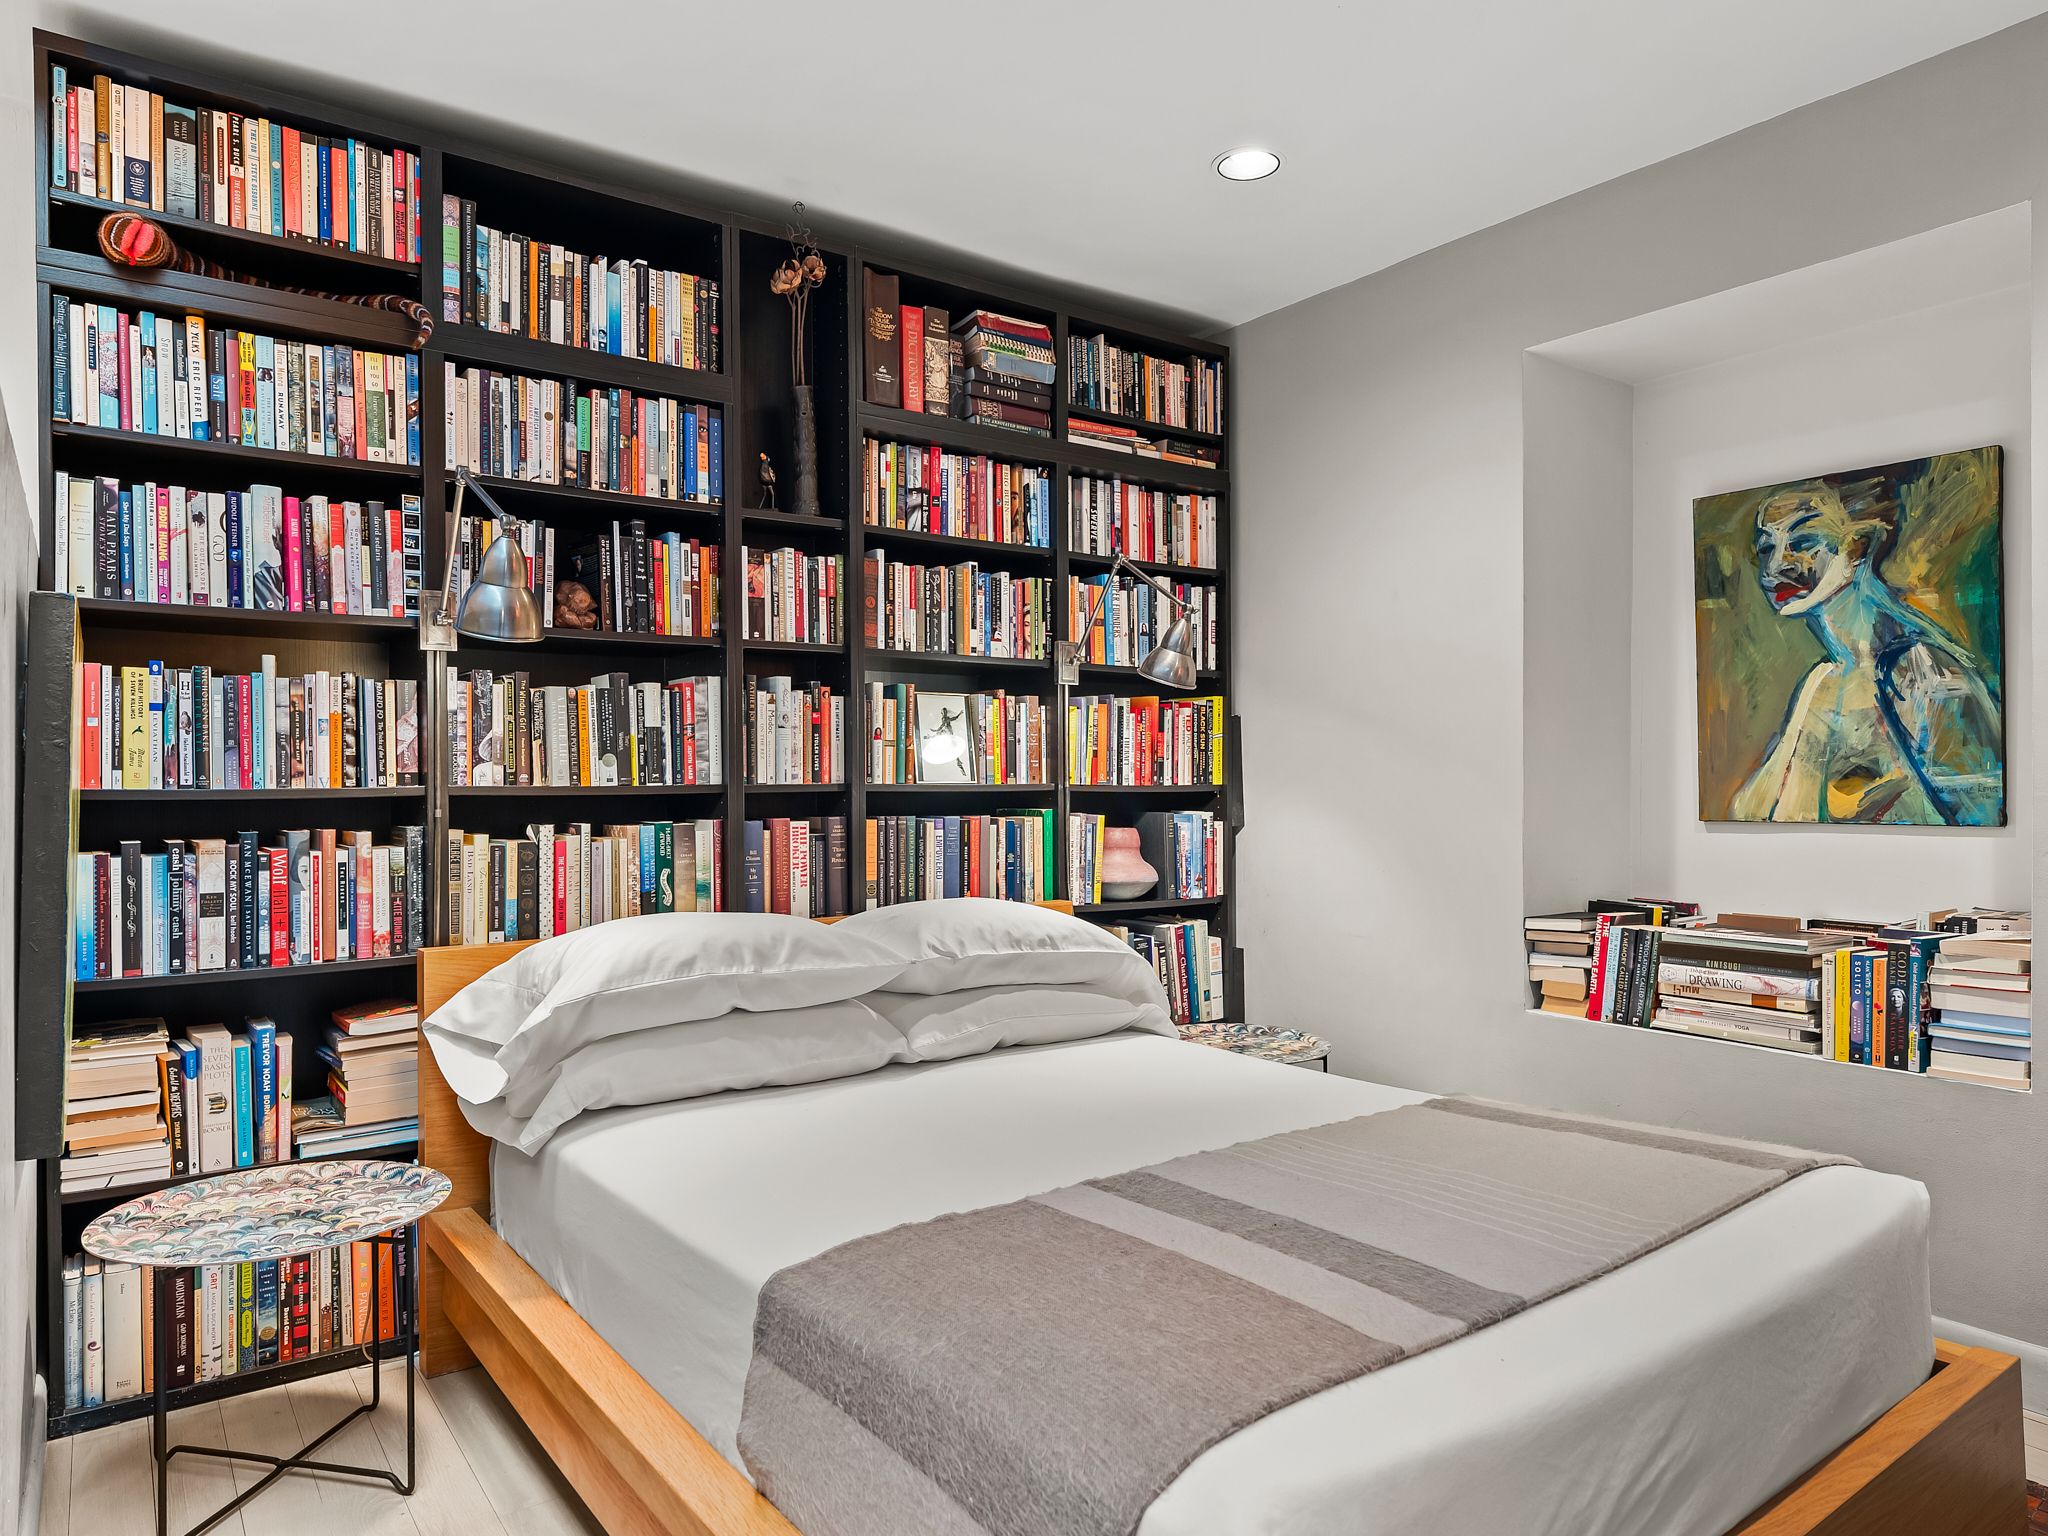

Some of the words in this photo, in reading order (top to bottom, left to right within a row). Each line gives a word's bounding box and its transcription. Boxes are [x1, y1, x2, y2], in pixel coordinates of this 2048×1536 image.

[233, 116, 241, 137] PEARL
[233, 148, 241, 165] BUCK
[289, 132, 301, 191] BIRDSONG
[58, 299, 66, 325] Setting
[58, 333, 66, 352] Table
[161, 338, 171, 360] Snow
[191, 331, 200, 353] YOLKS
[193, 360, 202, 382] ERIC
[907, 330, 919, 400] DICTIONARY
[57, 369, 66, 391] Danny
[213, 376, 223, 398] Salt
[57, 391, 66, 410] Meyer
[193, 386, 202, 418] RIPERT
[371, 395, 381, 416] bruce
[371, 418, 381, 444] wagner
[159, 505, 168, 529] EDDIE
[231, 496, 239, 520] RUDOLF
[58, 515, 67, 540] Shadow
[107, 510, 116, 537] IAIN
[231, 521, 239, 547] STEINER
[375, 516, 383, 536] david
[1090, 508, 1098, 540] SWERVE
[58, 541, 67, 557] Baby
[159, 531, 168, 562] HUANG
[213, 535, 225, 562] GOD
[375, 537, 383, 562] sedaris
[107, 541, 116, 580] PEARS
[376, 687, 384, 707] DARIO
[519, 690, 527, 716] Windup
[376, 709, 384, 719] FO
[519, 717, 527, 733] Girl
[128, 747, 138, 767] James
[137, 747, 145, 768] Marlon
[172, 848, 181, 871] cash
[244, 841, 252, 858] IAN
[450, 840, 461, 862] PALACE
[792, 826, 800, 871] BROKER
[935, 835, 943, 880] EMPOWERED
[244, 861, 252, 902] McEWAN
[273, 854, 288, 885] Wolf
[450, 863, 461, 881] WALK
[170, 877, 182, 913] johnny
[230, 880, 237, 892] MY
[273, 889, 288, 915] Hall
[393, 901, 402, 917] KITE
[170, 916, 182, 939] cash
[393, 916, 402, 944] RUNNER
[1603, 921, 1611, 938] THE
[1591, 915, 1604, 966] WANDERING
[1621, 937, 1629, 965] MEMORY
[1640, 940, 1650, 977] DESOLATION
[1705, 960, 1741, 971] KINTSUGI
[1889, 950, 1898, 985] BREAKER
[1898, 951, 1907, 987] CODE
[1179, 956, 1187, 988] Charles
[1589, 967, 1599, 994] EARTH
[1618, 966, 1626, 989] CALLED
[1688, 974, 1743, 991] DRAWING
[1855, 960, 1863, 995] SOLITO
[1182, 988, 1190, 1017] Bargue
[203, 1054, 230, 1064] SEVEN
[262, 1033, 270, 1066] TREVOR
[204, 1072, 230, 1081] PLOTS
[205, 1062, 230, 1072] BASIC
[262, 1068, 270, 1092] NOAH
[176, 1277, 185, 1319] MOUNTAIN
[68, 1300, 77, 1324] McElroy
